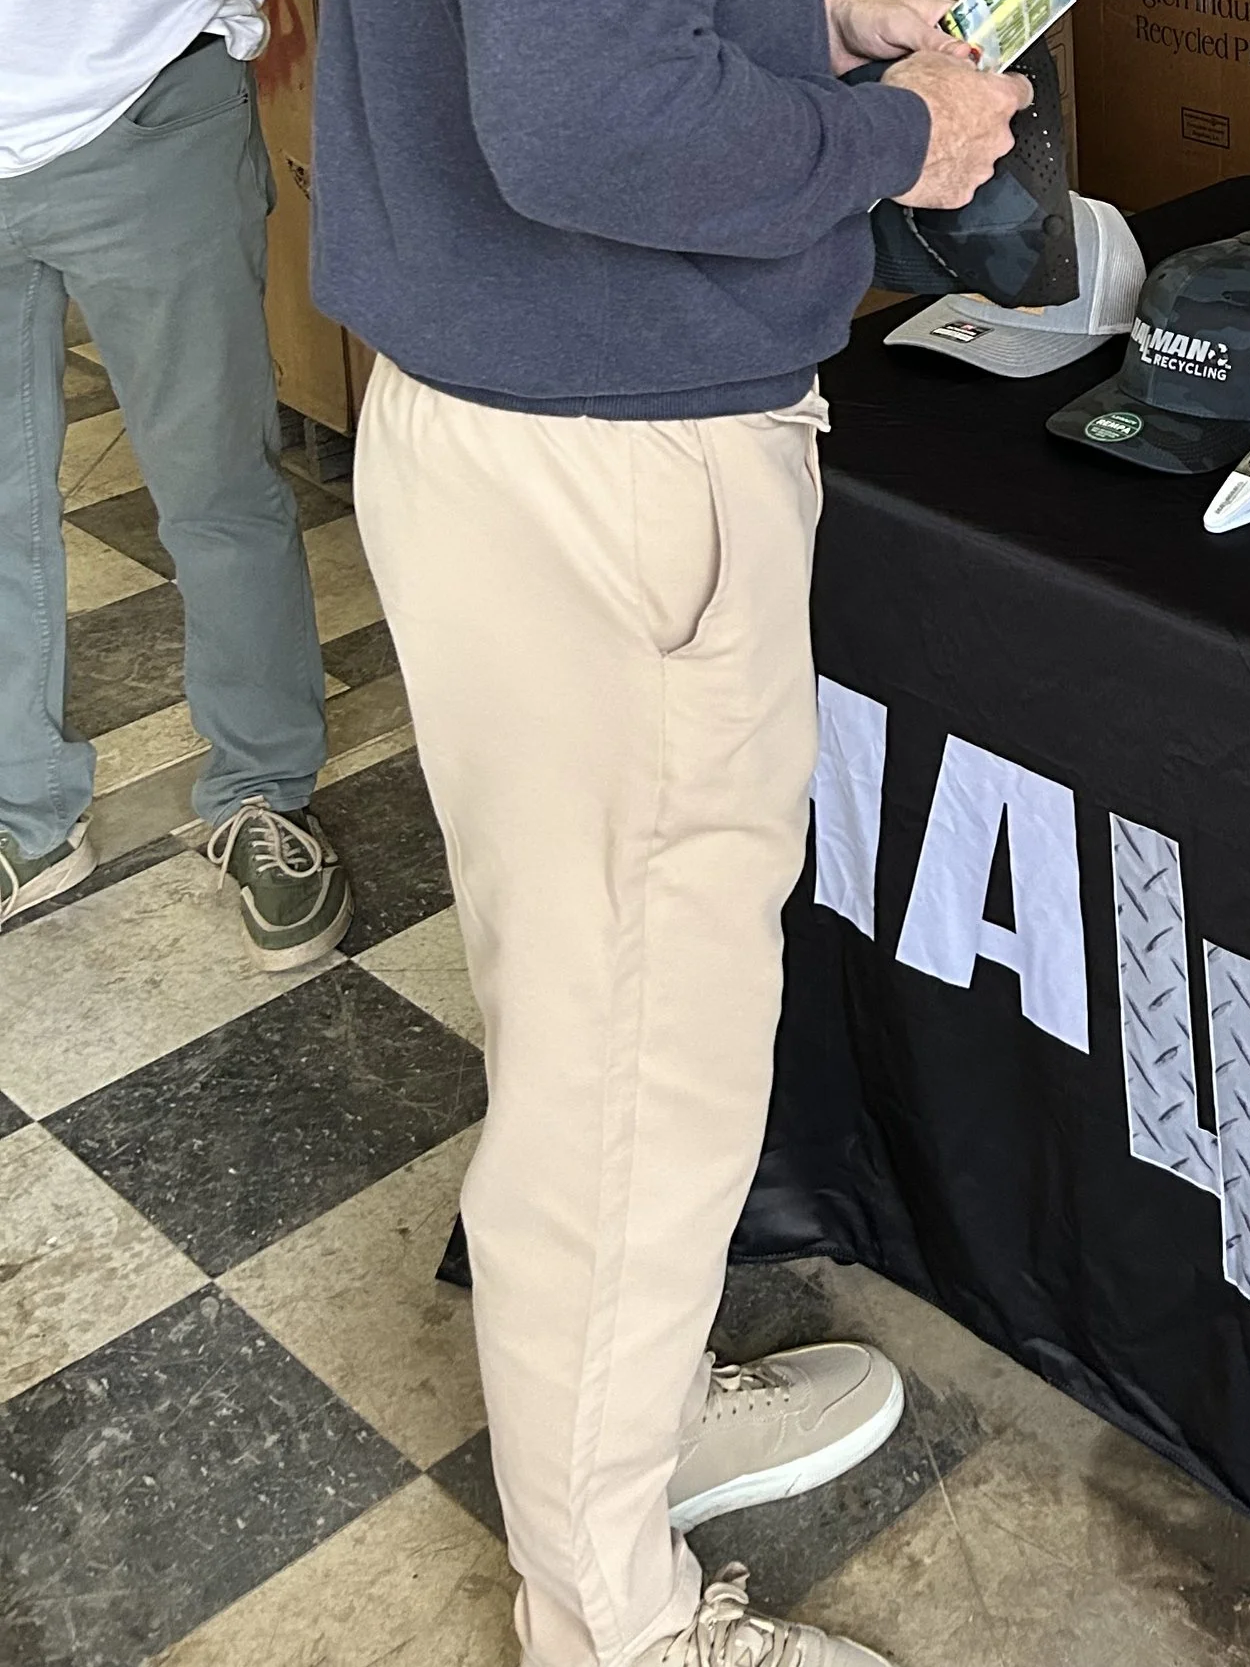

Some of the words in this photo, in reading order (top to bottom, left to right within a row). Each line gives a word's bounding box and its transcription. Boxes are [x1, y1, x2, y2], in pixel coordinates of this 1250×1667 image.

[1135, 14, 1229, 60] Recycled
[1152, 353, 1228, 381] RECYCLING
[1095, 418, 1132, 435] REMPA
